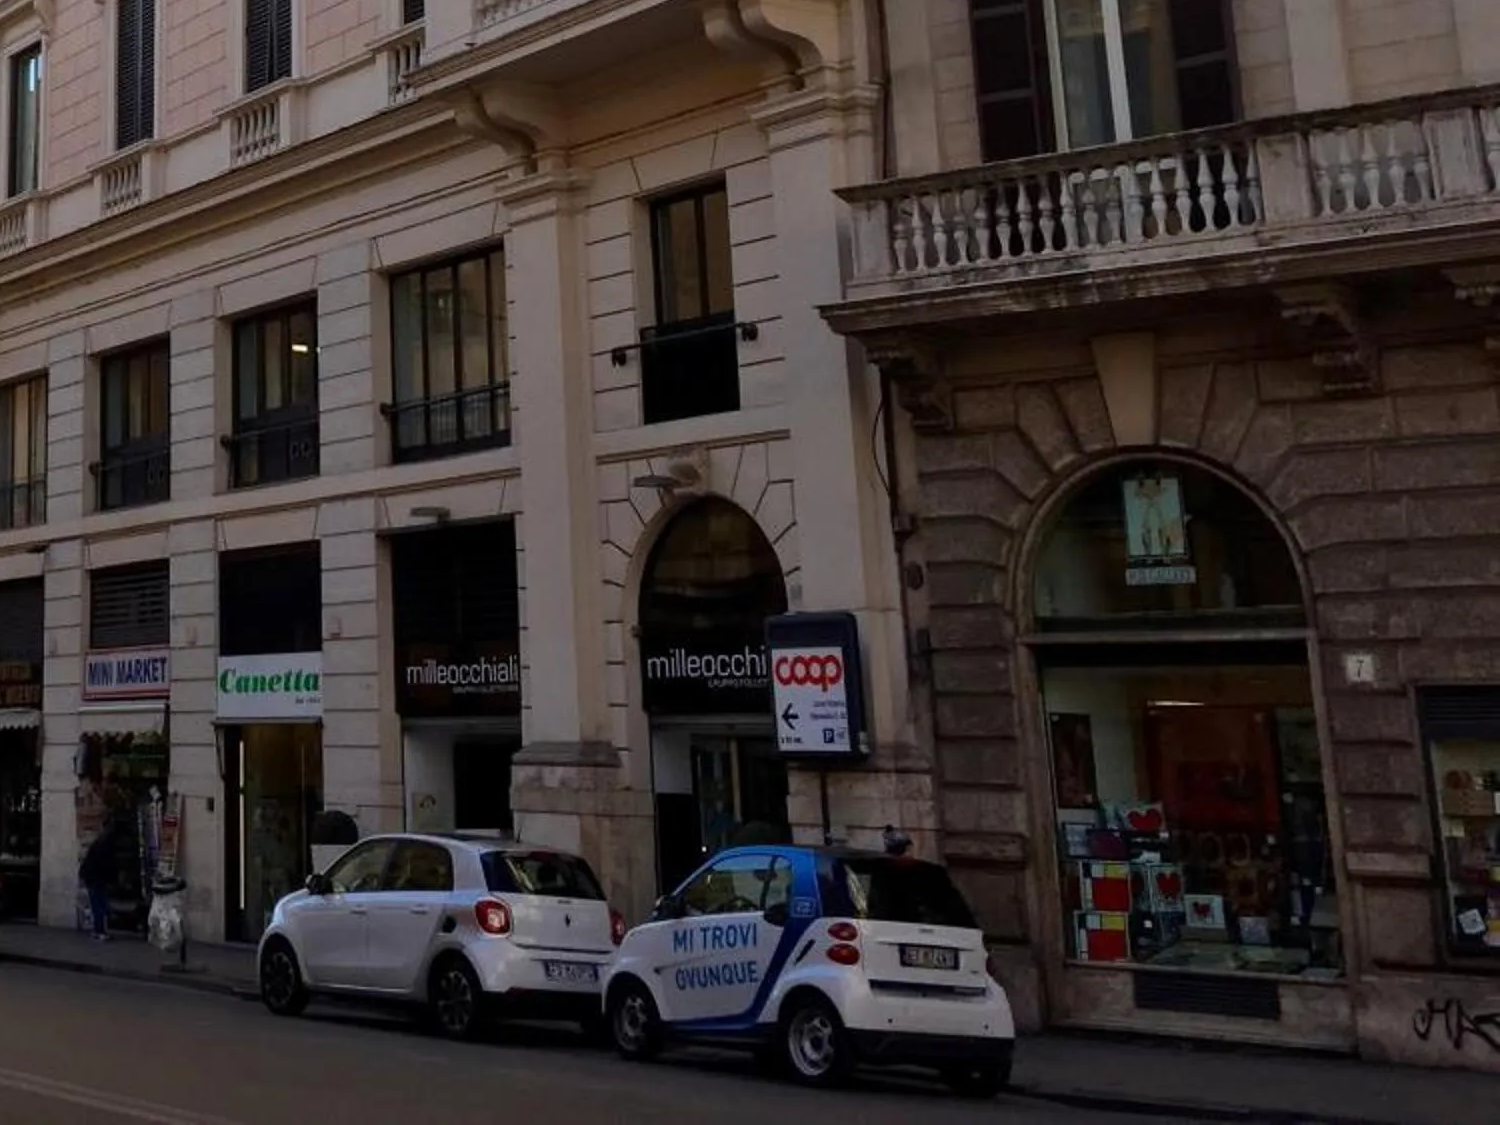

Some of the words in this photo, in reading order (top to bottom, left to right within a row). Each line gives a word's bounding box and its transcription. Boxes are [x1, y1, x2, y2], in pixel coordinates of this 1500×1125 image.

[88, 662, 113, 686] MINI
[116, 656, 167, 684] MARKET
[219, 668, 319, 694] Canetta
[406, 654, 518, 684] milleocchiali
[776, 655, 841, 691] coop
[673, 929, 694, 953] MI
[700, 923, 757, 950] TROVI
[675, 961, 760, 991] OVUNQUE
